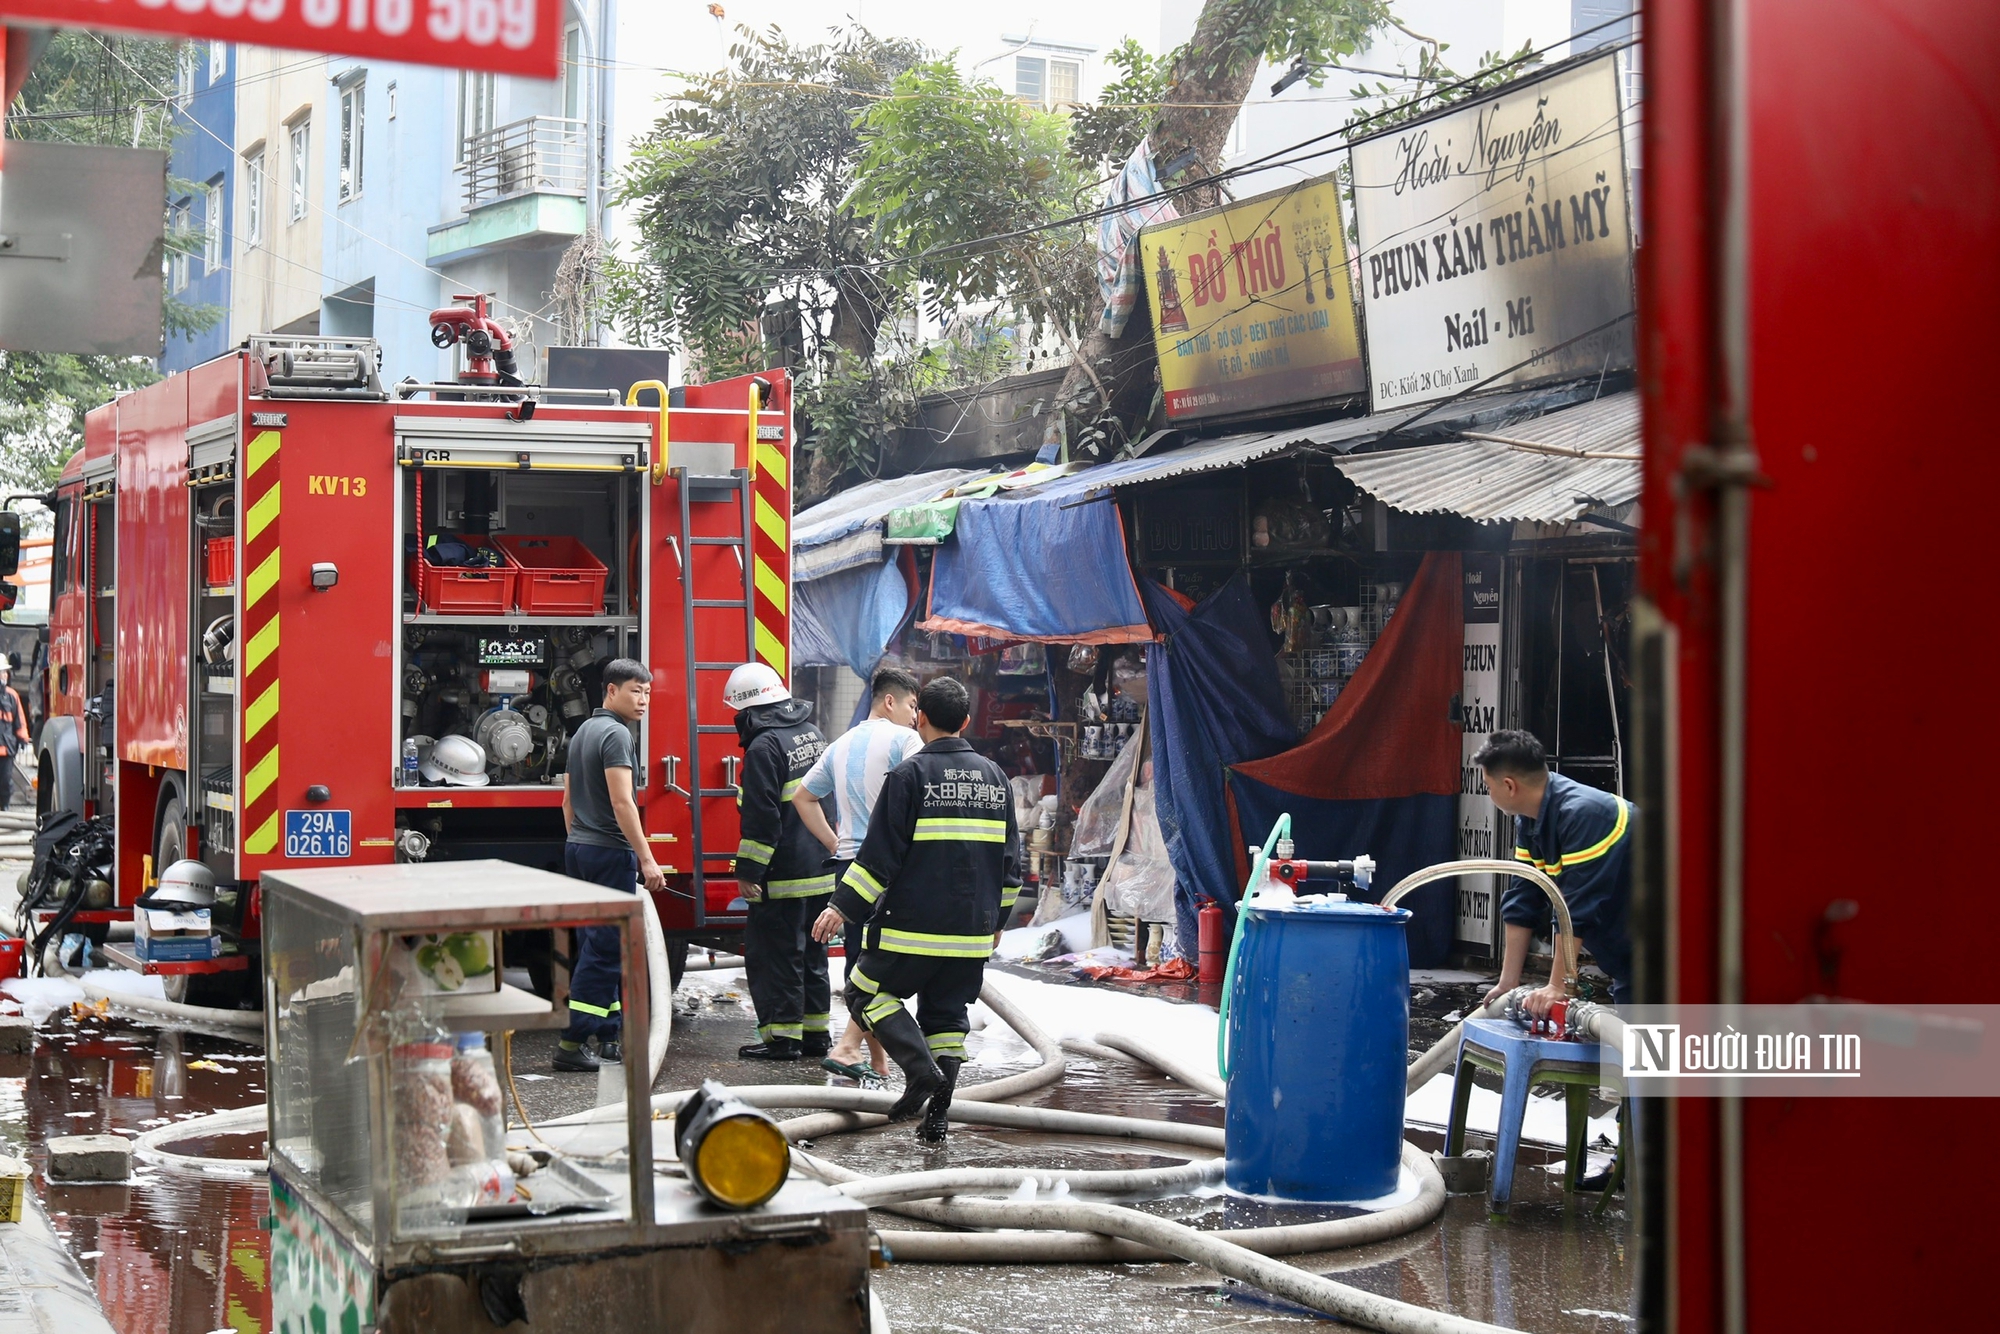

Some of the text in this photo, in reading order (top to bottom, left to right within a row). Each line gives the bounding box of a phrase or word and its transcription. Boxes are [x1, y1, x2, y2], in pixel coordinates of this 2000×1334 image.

[427, 0, 537, 49] 569
[1394, 95, 1562, 196] Hoài Nguyễn
[1369, 169, 1611, 299] PHUN XĂM THẨM MỸ
[1188, 220, 1286, 307] ĐỒ THỜ
[1249, 320, 1268, 341] ĐÈN
[1269, 314, 1286, 337] THỜ
[1287, 311, 1306, 334] CÁC
[1308, 309, 1330, 333] LOẠI
[1444, 307, 1489, 353] Nail
[1505, 296, 1535, 338] Mi
[1399, 371, 1419, 396] Kiốt
[1420, 373, 1431, 391] 28
[1433, 370, 1452, 390] Chợ
[1454, 363, 1479, 385] Xanh
[308, 475, 367, 497] KV13
[1463, 644, 1497, 672] PHUN
[1462, 697, 1495, 733] XĂM
[787, 740, 828, 766] 大田原消
[943, 768, 984, 782] 栃木県
[923, 782, 1006, 803] 大田原消防
[923, 800, 967, 808] OHTAWARA
[968, 801, 984, 809] FIRE
[301, 813, 335, 833] 29A
[287, 834, 349, 855] 026.16
[1473, 891, 1490, 927] THỊT
